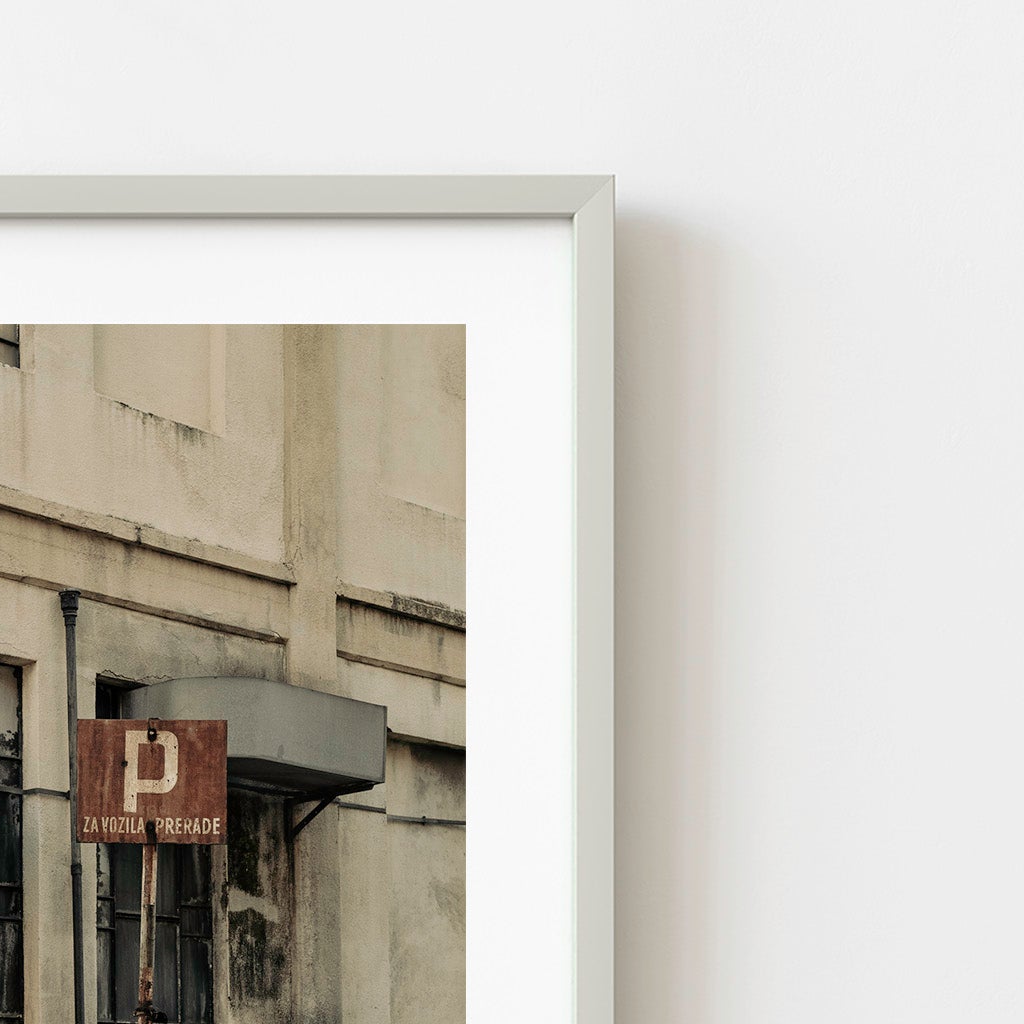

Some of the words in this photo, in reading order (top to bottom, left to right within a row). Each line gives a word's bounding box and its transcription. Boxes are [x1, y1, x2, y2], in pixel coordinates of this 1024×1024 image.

[123, 730, 179, 813] P
[83, 816, 99, 833] ZA
[101, 816, 146, 834] VOZILA
[155, 817, 221, 835] PRERADE
